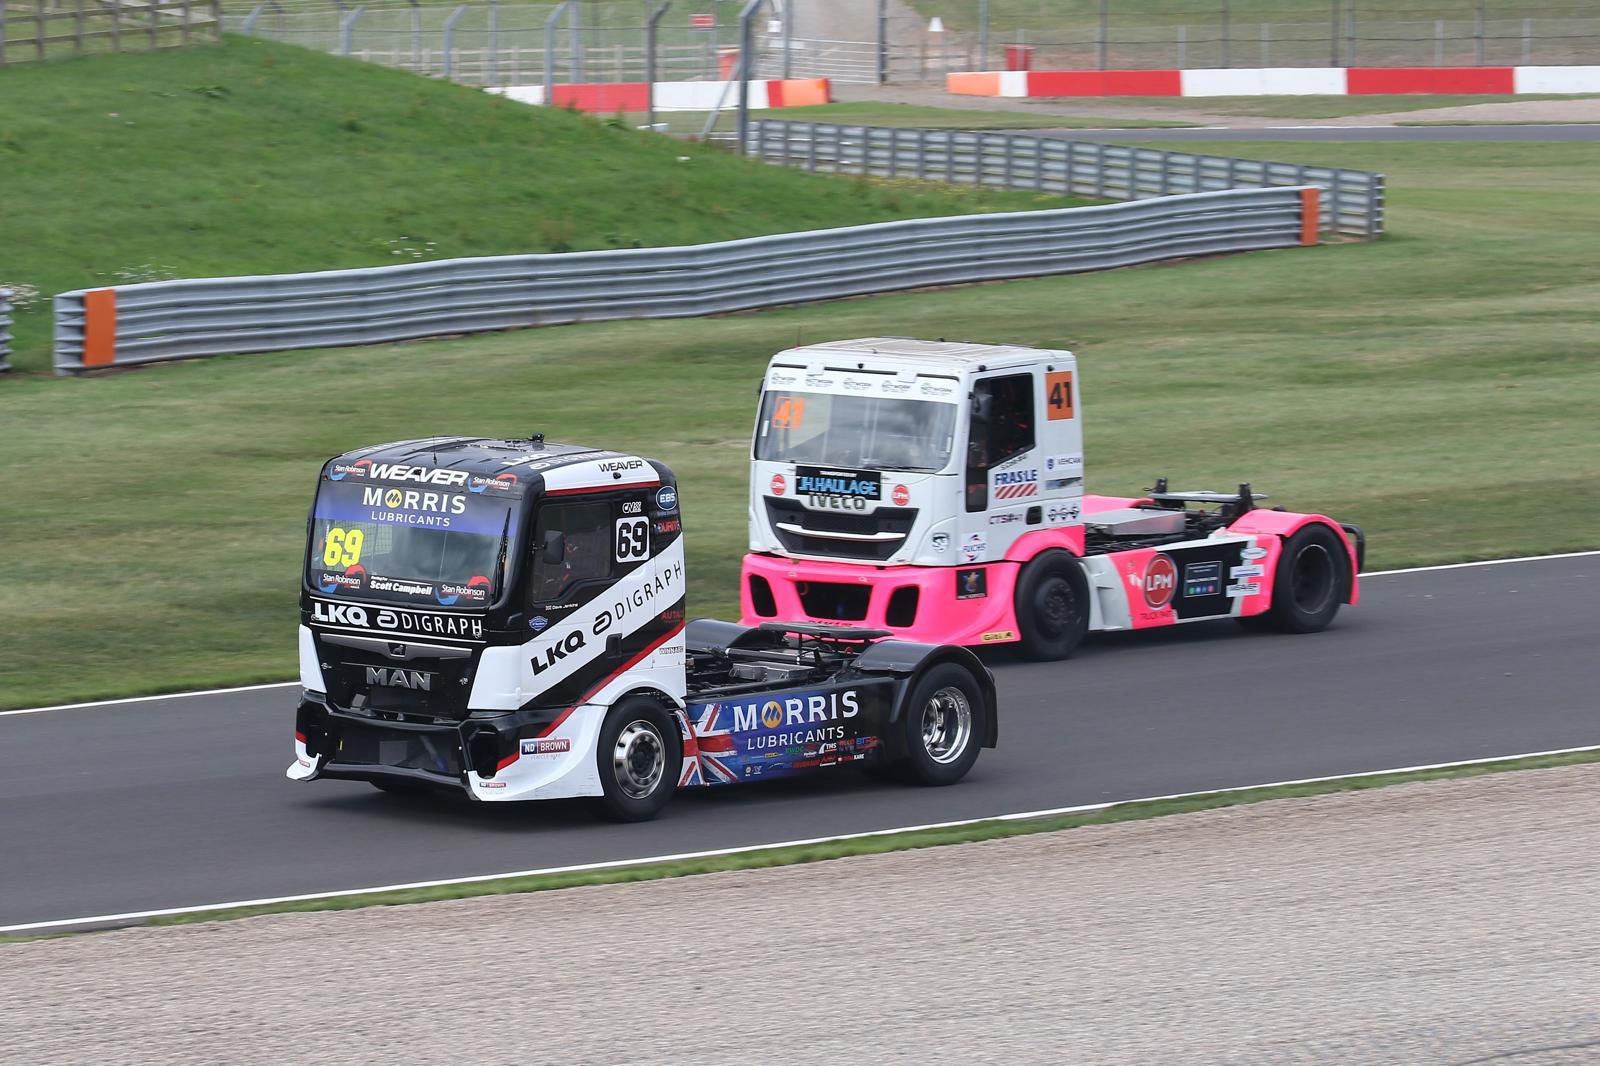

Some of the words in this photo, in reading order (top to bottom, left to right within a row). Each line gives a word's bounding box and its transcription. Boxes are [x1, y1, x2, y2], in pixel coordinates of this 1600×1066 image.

[1048, 381, 1073, 409] 41
[773, 397, 804, 428] 41
[370, 463, 469, 486] WEAVER
[599, 459, 643, 472] WEAVER
[362, 487, 467, 514] MORRIS
[660, 493, 676, 503] EBS
[807, 491, 866, 511] IVECO
[371, 511, 451, 527] LUBRICANTS
[323, 527, 365, 567] 69
[618, 520, 649, 558] 69
[323, 573, 335, 582] Stan
[335, 574, 361, 585] Robinson
[370, 580, 392, 591] Scott
[392, 582, 433, 595] Campbell
[441, 584, 455, 593] Stan
[455, 586, 485, 596] Robinson
[615, 560, 682, 620] DIGRAPH
[1147, 573, 1173, 592] LPM
[314, 602, 370, 628] LKQ
[400, 612, 484, 636] DIGRAPH
[530, 630, 586, 676] LKQ
[366, 667, 431, 691] MAN
[733, 690, 859, 732] MORRIS
[524, 743, 535, 752] ND
[540, 741, 567, 752] BROWN
[747, 726, 844, 750] LUBRICANTS
